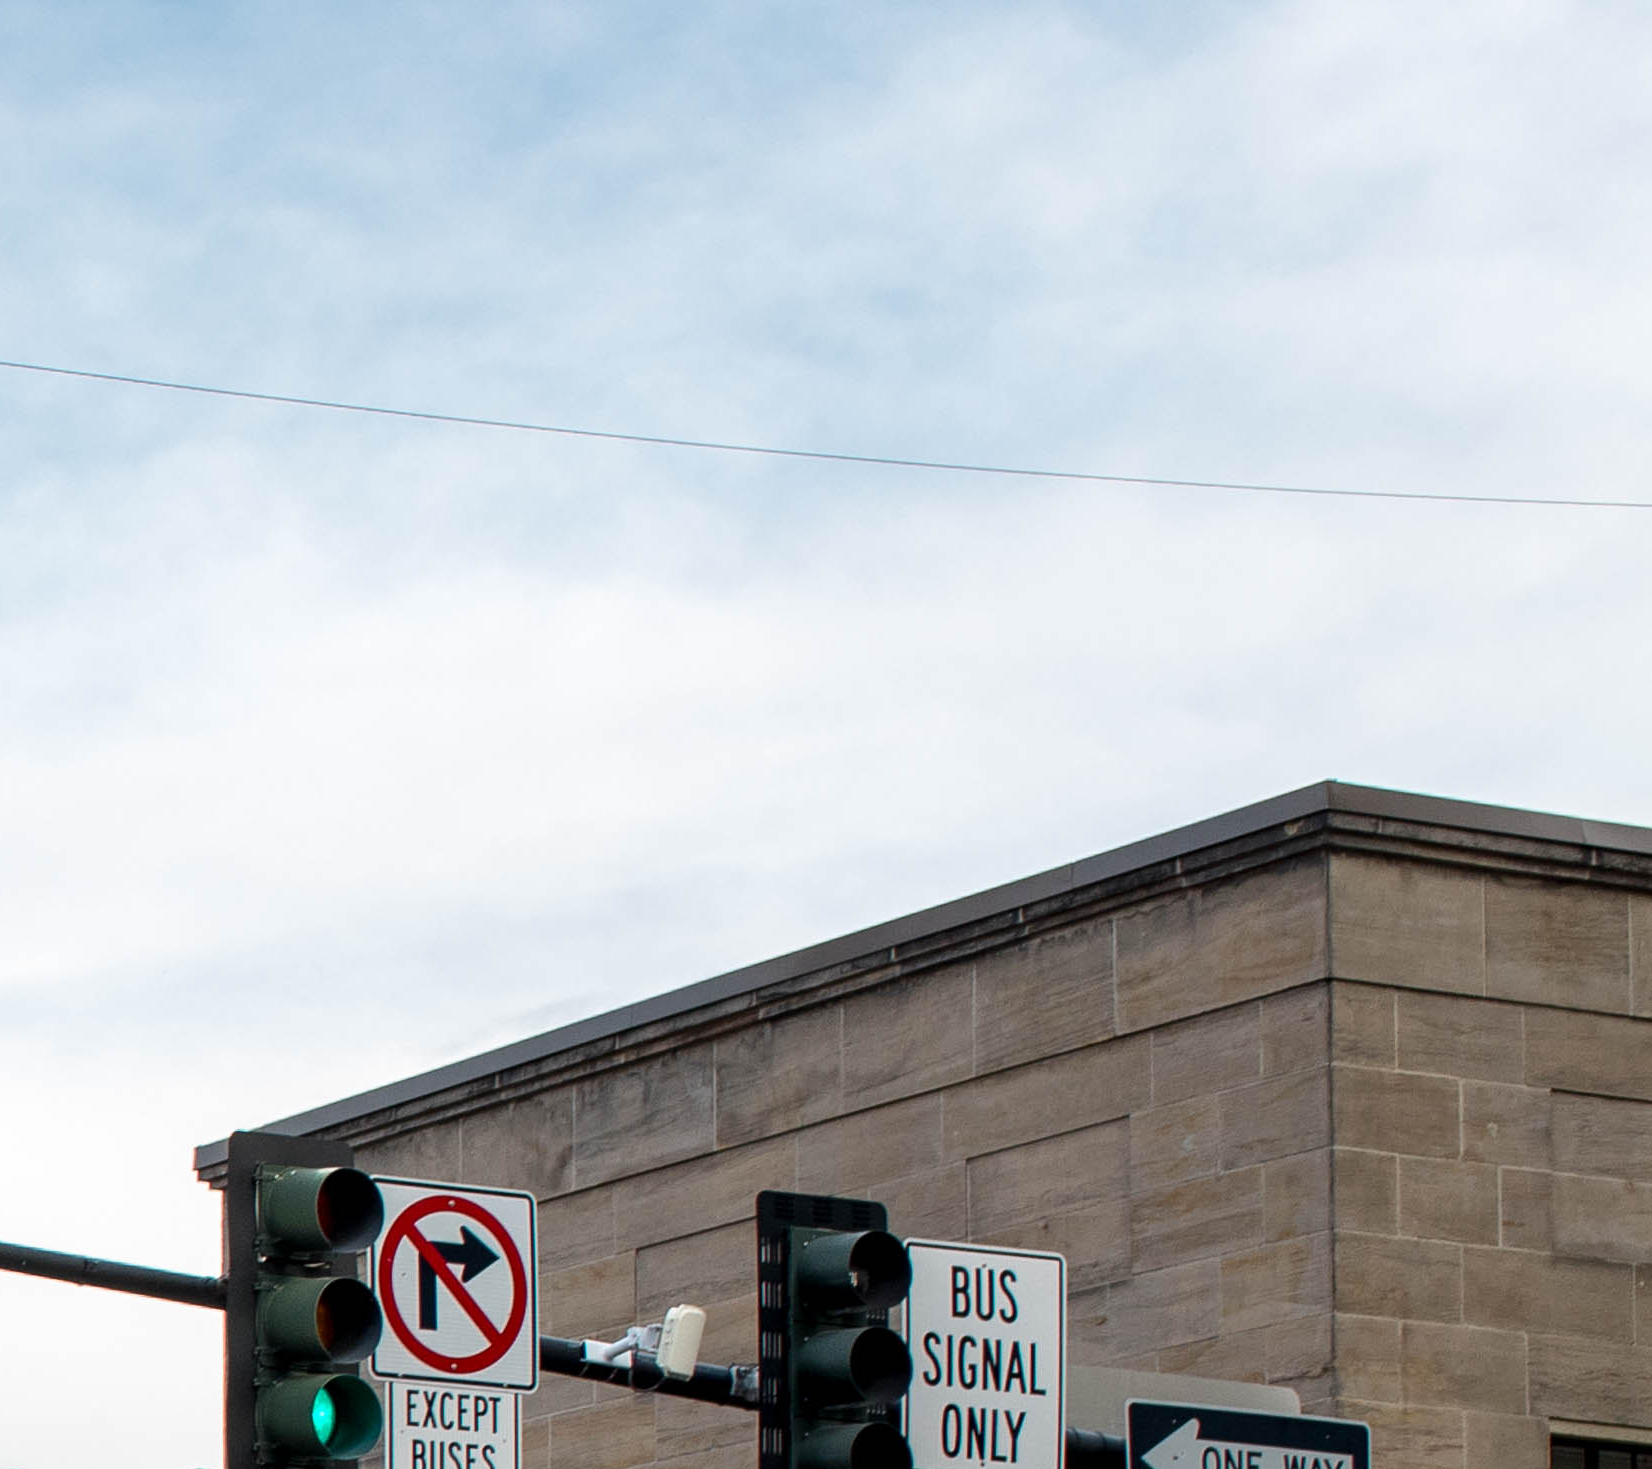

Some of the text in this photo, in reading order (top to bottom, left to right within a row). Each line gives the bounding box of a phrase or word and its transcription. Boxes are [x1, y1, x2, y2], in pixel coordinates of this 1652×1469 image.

[950, 1264, 1018, 1324] BUS
[922, 1331, 1047, 1397] SIGNAL
[406, 1389, 502, 1434] EXCEPT
[942, 1403, 1027, 1464] ONLY
